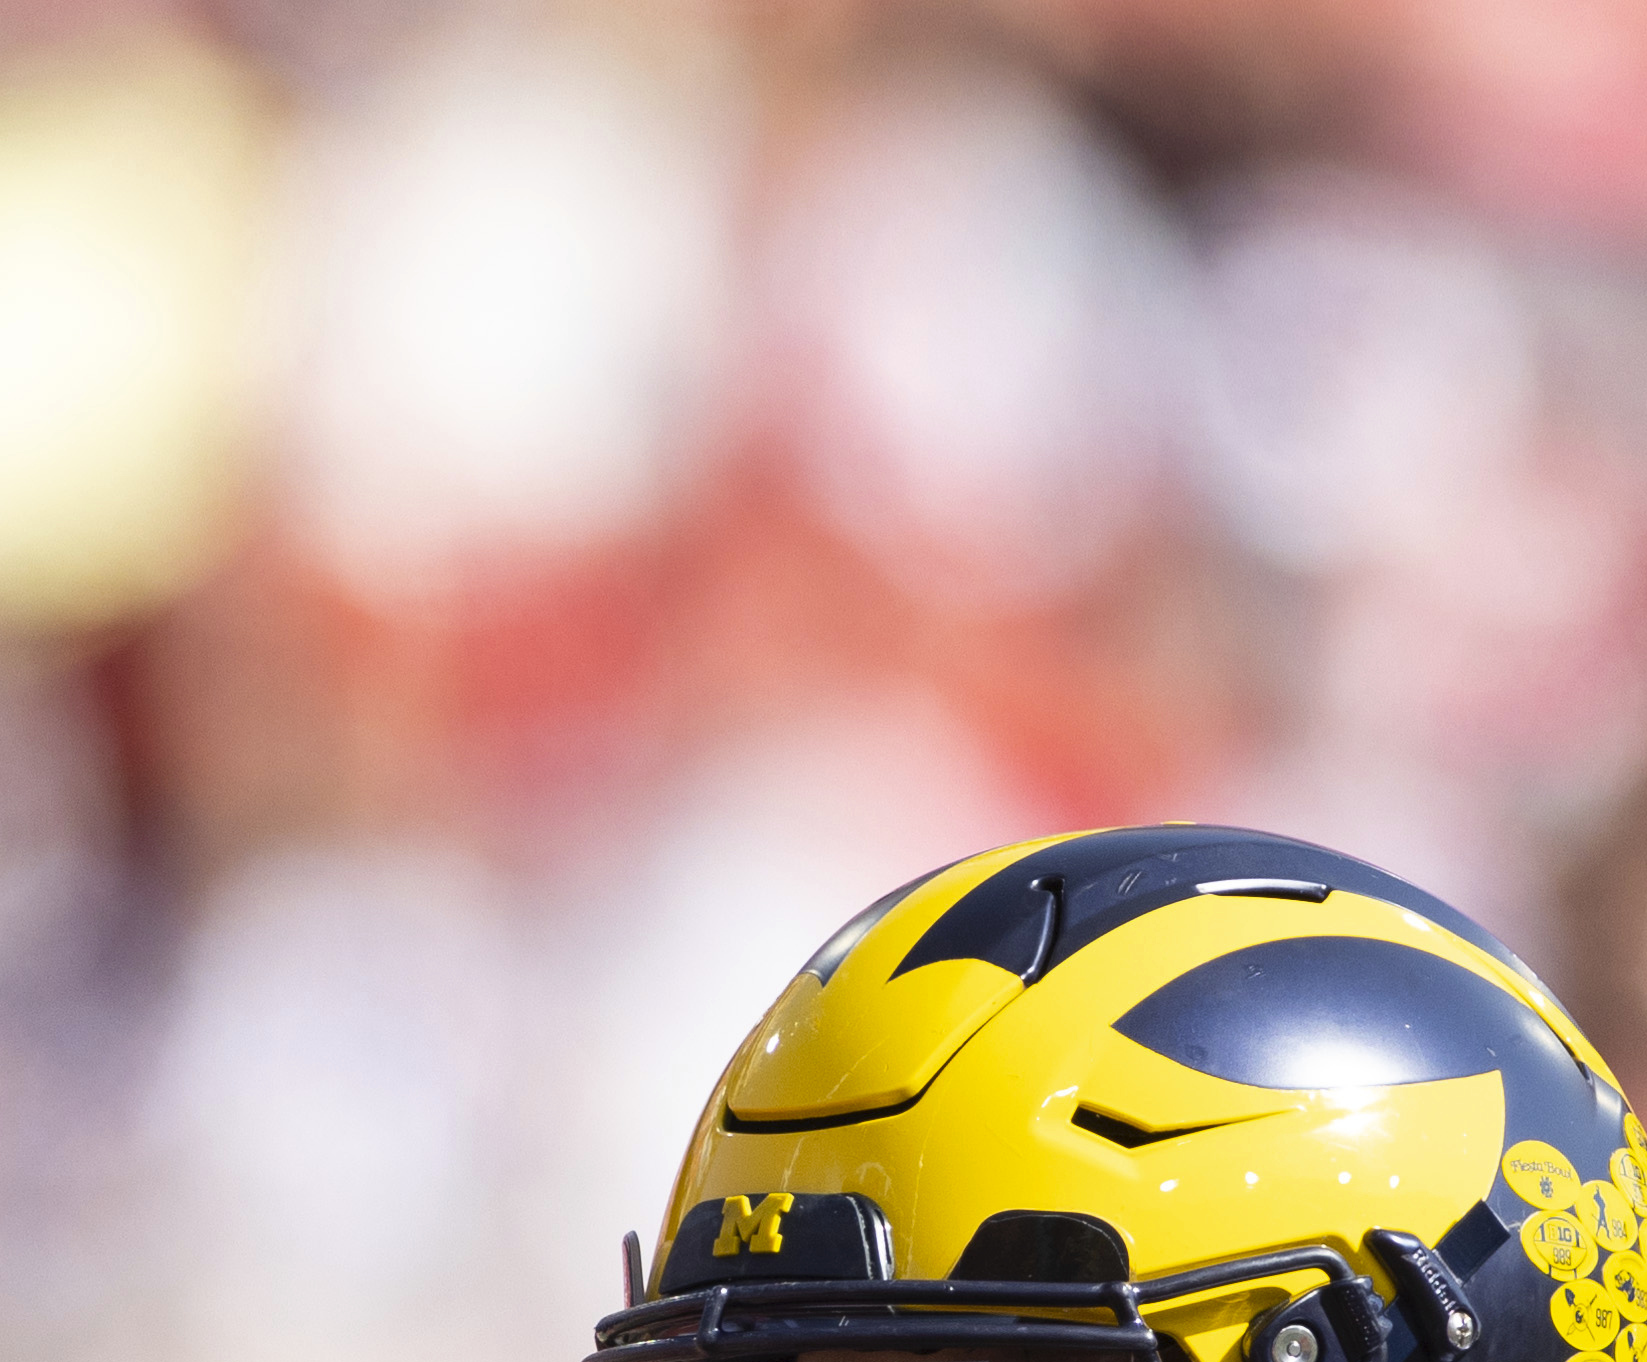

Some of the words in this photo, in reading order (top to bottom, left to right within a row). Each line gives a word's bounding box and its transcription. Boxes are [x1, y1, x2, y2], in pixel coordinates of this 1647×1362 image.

[1510, 1159, 1543, 1173] Fiesta
[1543, 1161, 1572, 1180] Bowl
[713, 1193, 794, 1257] M
[1595, 1308, 1613, 1330] 987
